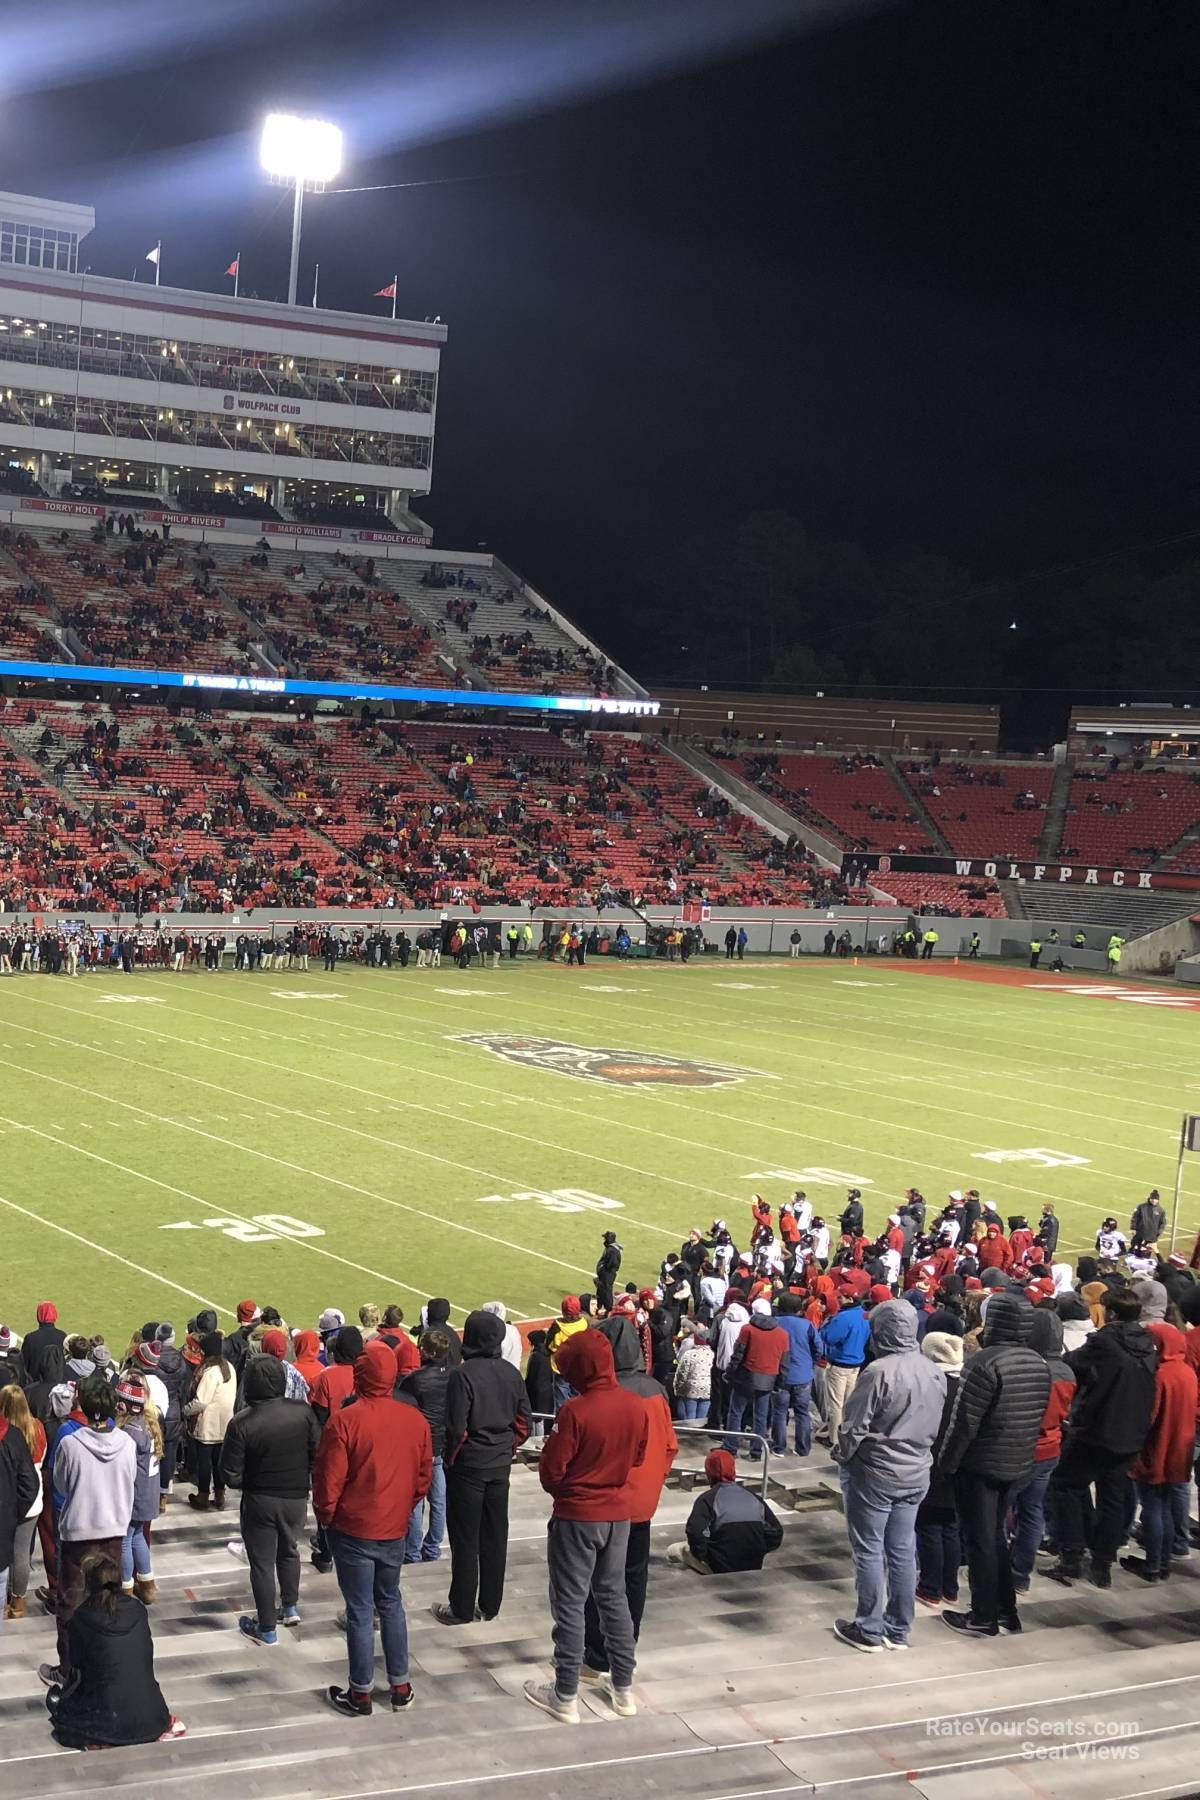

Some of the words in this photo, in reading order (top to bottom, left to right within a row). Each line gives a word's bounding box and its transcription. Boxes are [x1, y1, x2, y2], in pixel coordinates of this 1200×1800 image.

[238, 399, 279, 413] WOLFPACK
[281, 405, 301, 415] CLUB
[44, 502, 72, 513] TORRY
[75, 506, 98, 515] HOLT
[161, 513, 189, 524] PHILIP
[191, 517, 221, 527] RIVERS
[277, 525, 302, 534] MARIO
[303, 527, 340, 538] WILLIAMS
[373, 533, 405, 543] BRADLEY
[406, 536, 431, 545] CHUBB
[956, 861, 1152, 888] WOLFPACK
[511, 1188, 625, 1213] 30
[203, 1213, 326, 1242] 20
